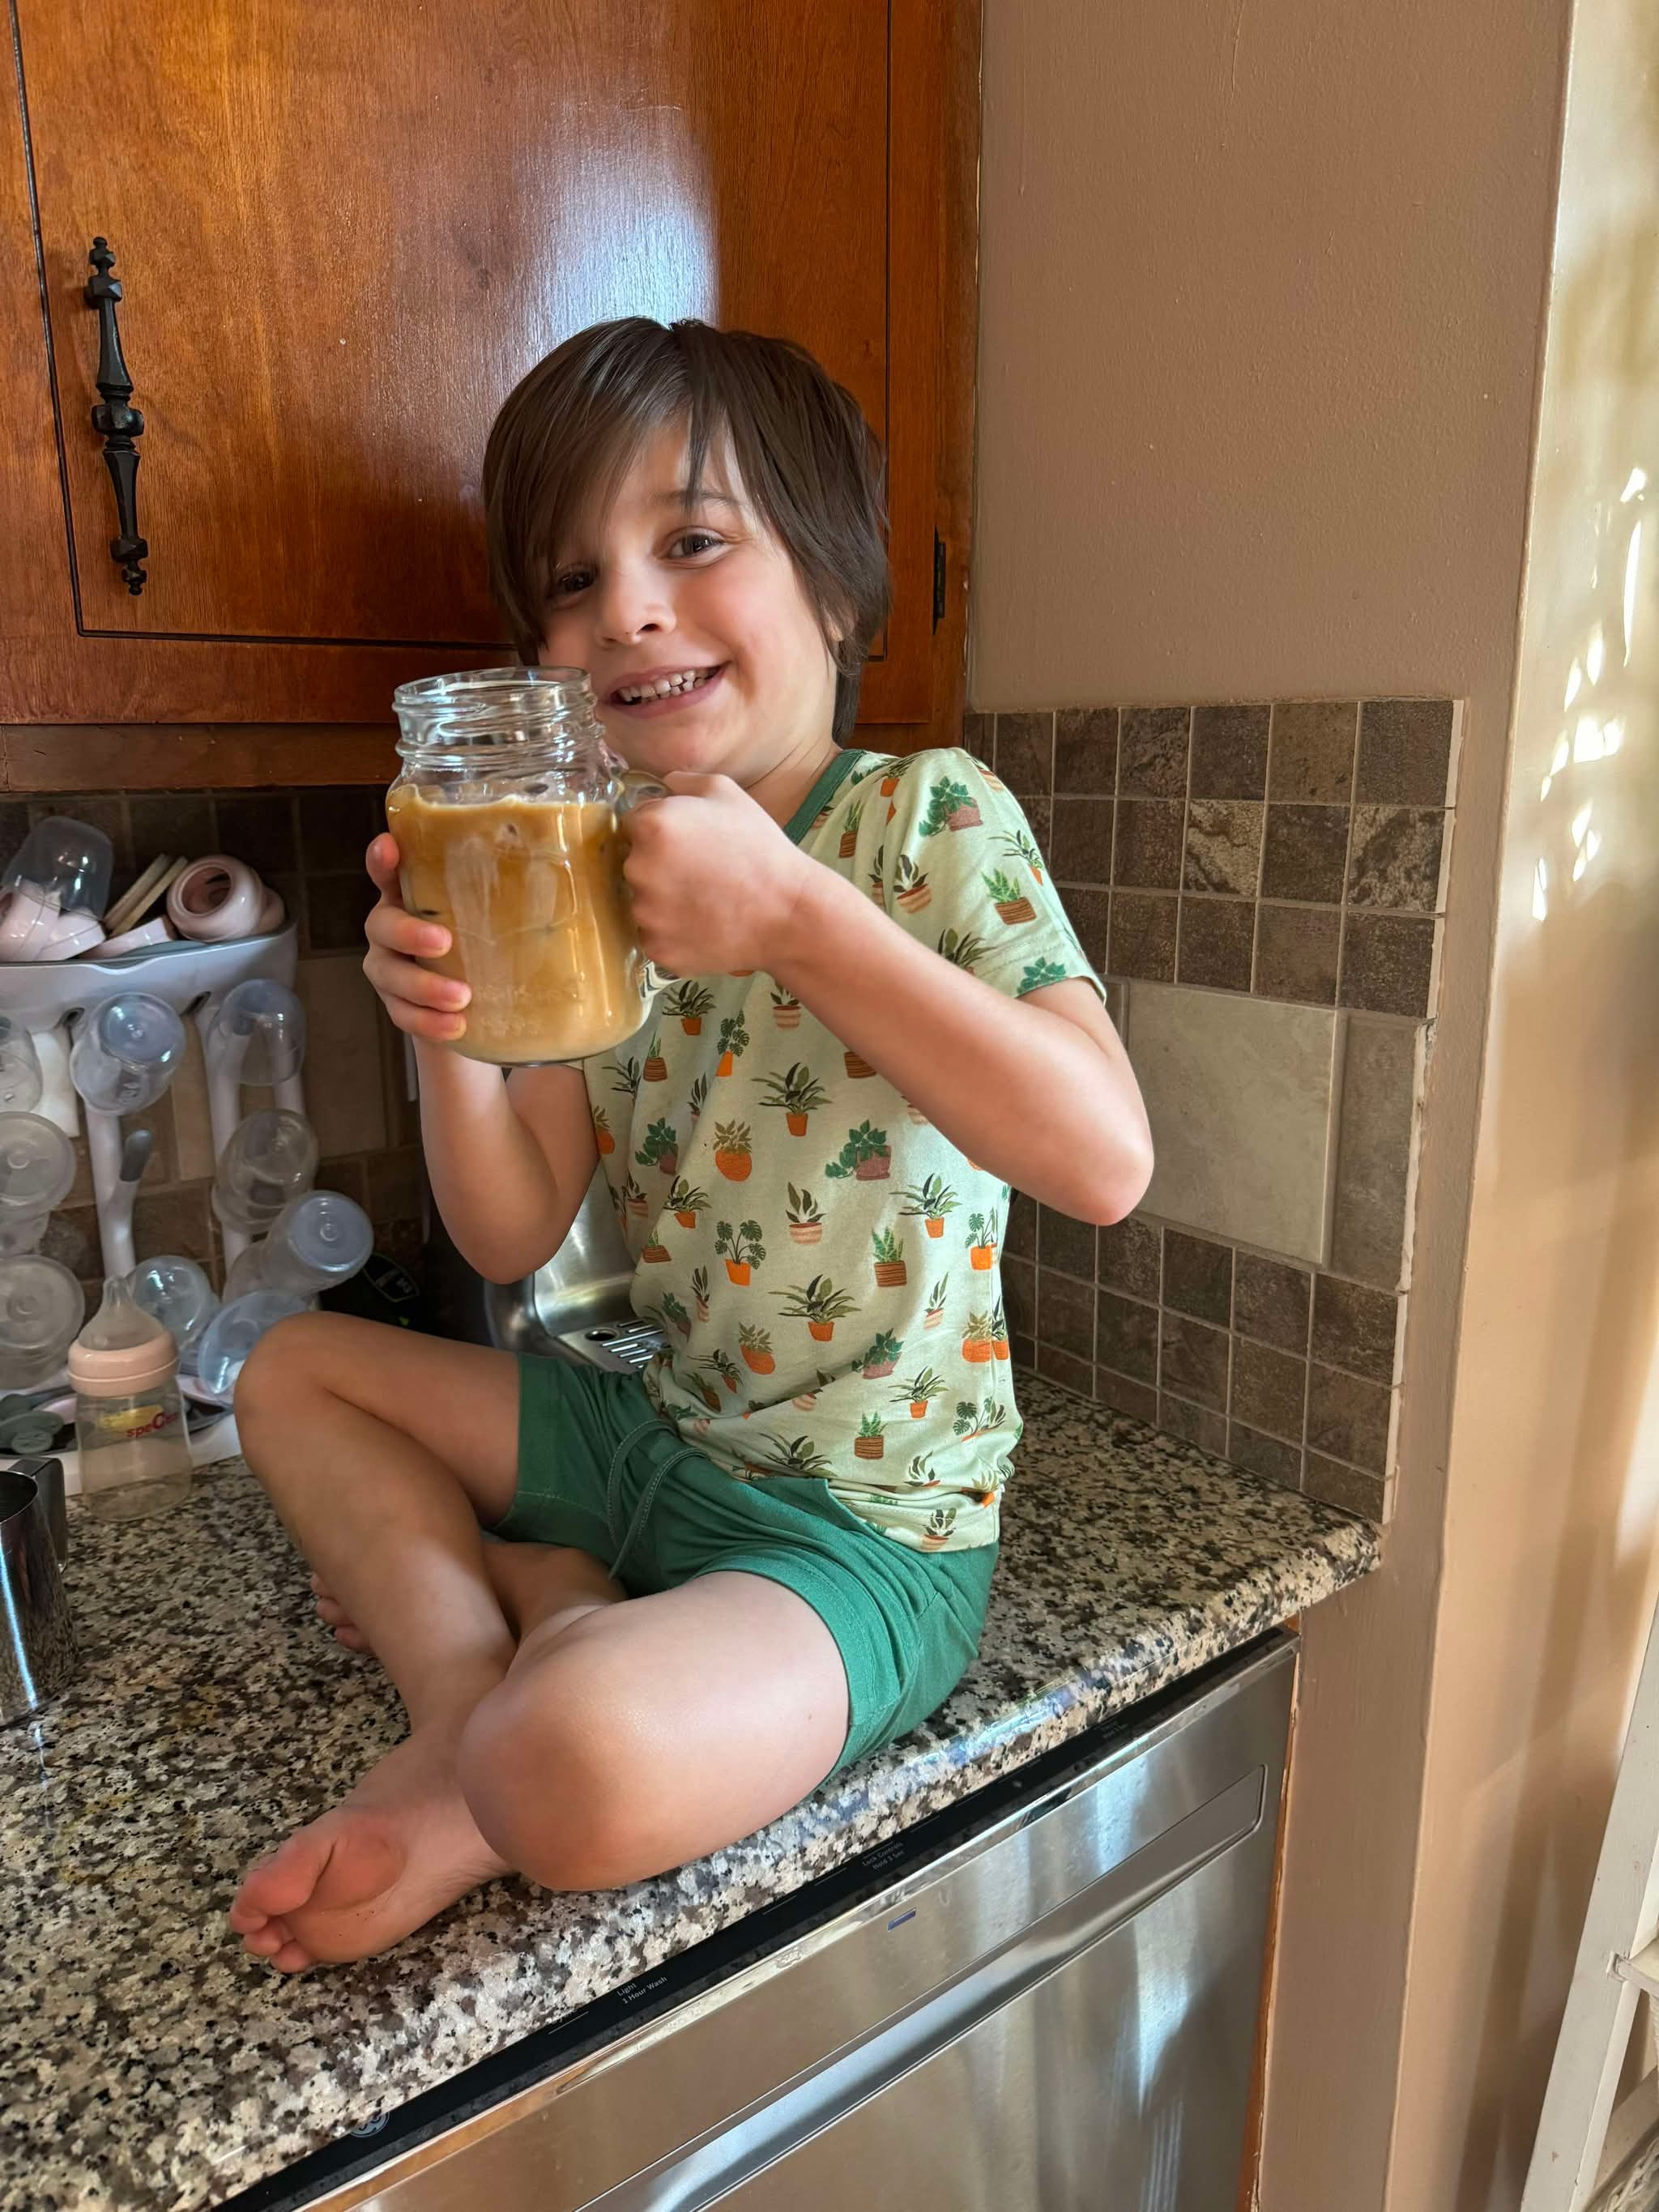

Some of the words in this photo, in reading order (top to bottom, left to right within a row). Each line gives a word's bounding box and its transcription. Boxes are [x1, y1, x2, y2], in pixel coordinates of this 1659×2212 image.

[616, 1983, 638, 1997] Light
[621, 1997, 629, 2005] 1
[628, 1988, 647, 2001] Hour
[646, 1976, 668, 1991] Wash
